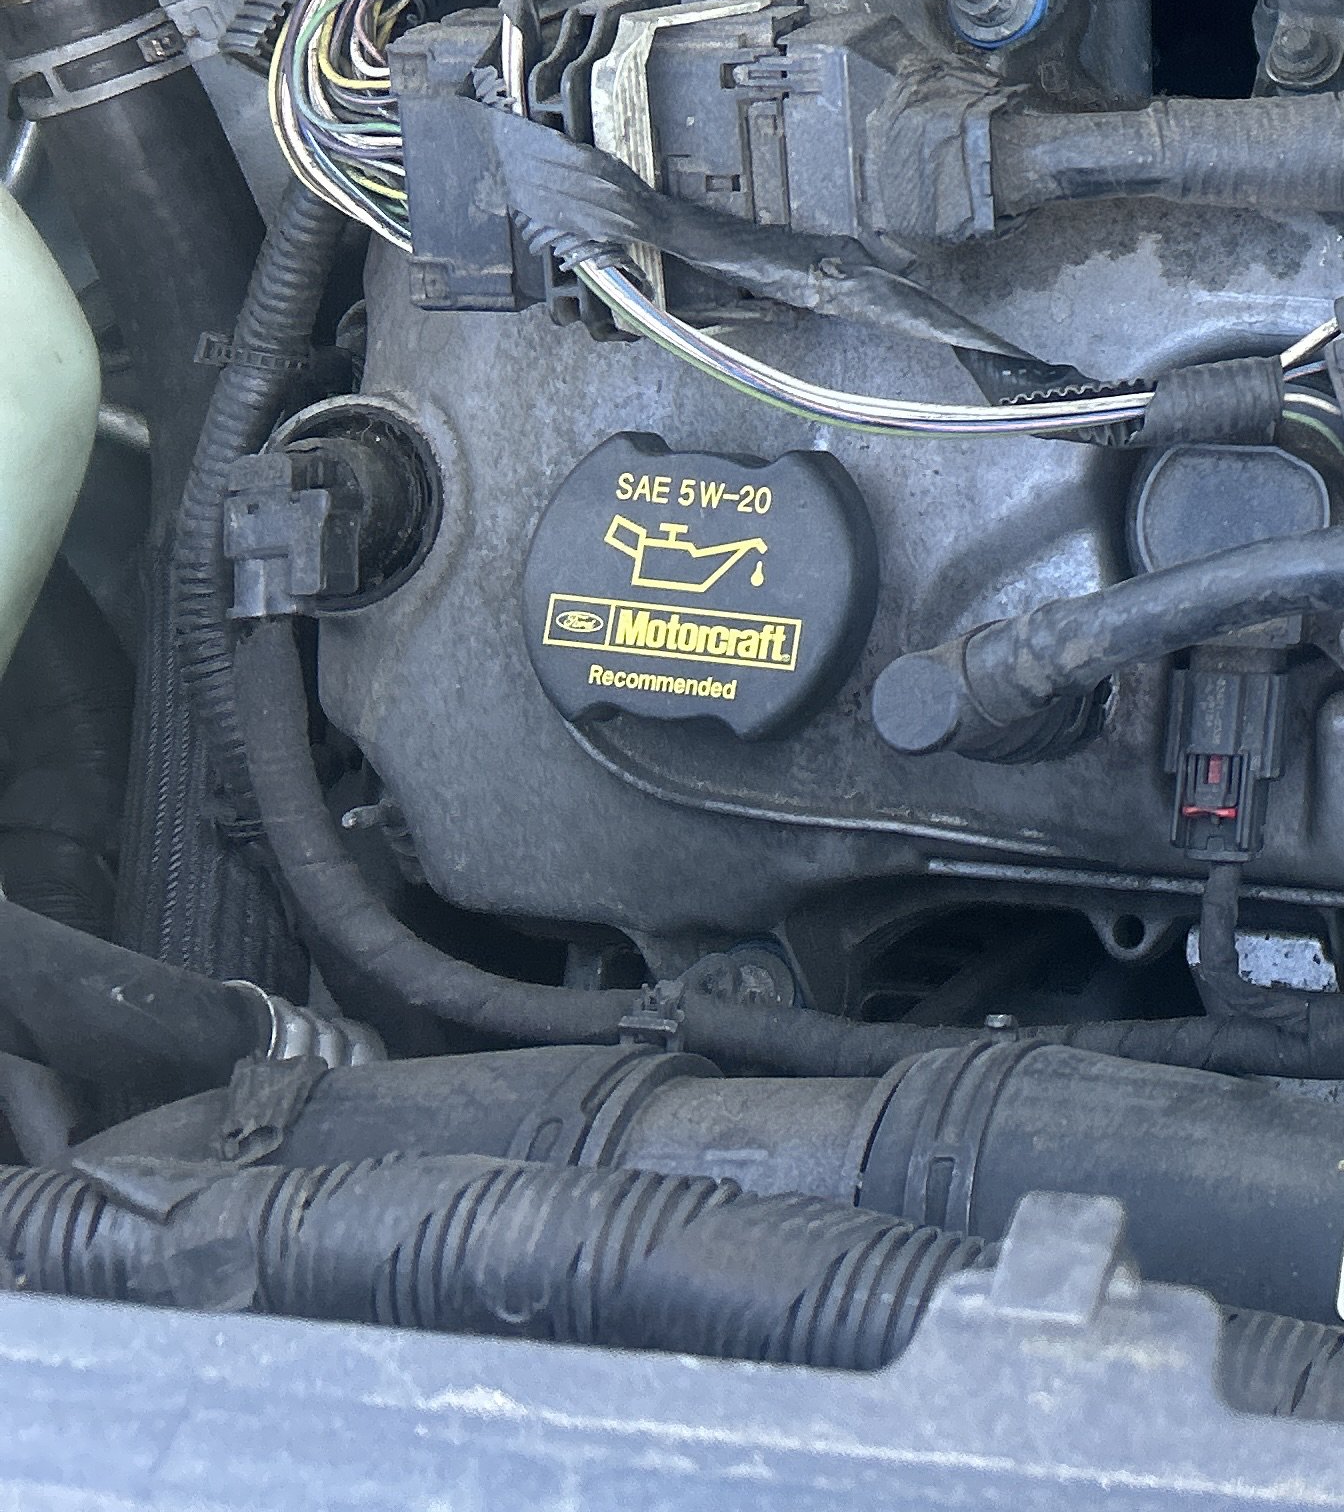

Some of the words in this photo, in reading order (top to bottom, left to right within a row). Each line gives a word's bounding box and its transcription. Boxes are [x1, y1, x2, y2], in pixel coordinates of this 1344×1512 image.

[615, 472, 672, 505] SAE
[678, 479, 772, 514] 5W-20
[615, 609, 788, 662] Motorcraft
[588, 664, 737, 700] Recommended
